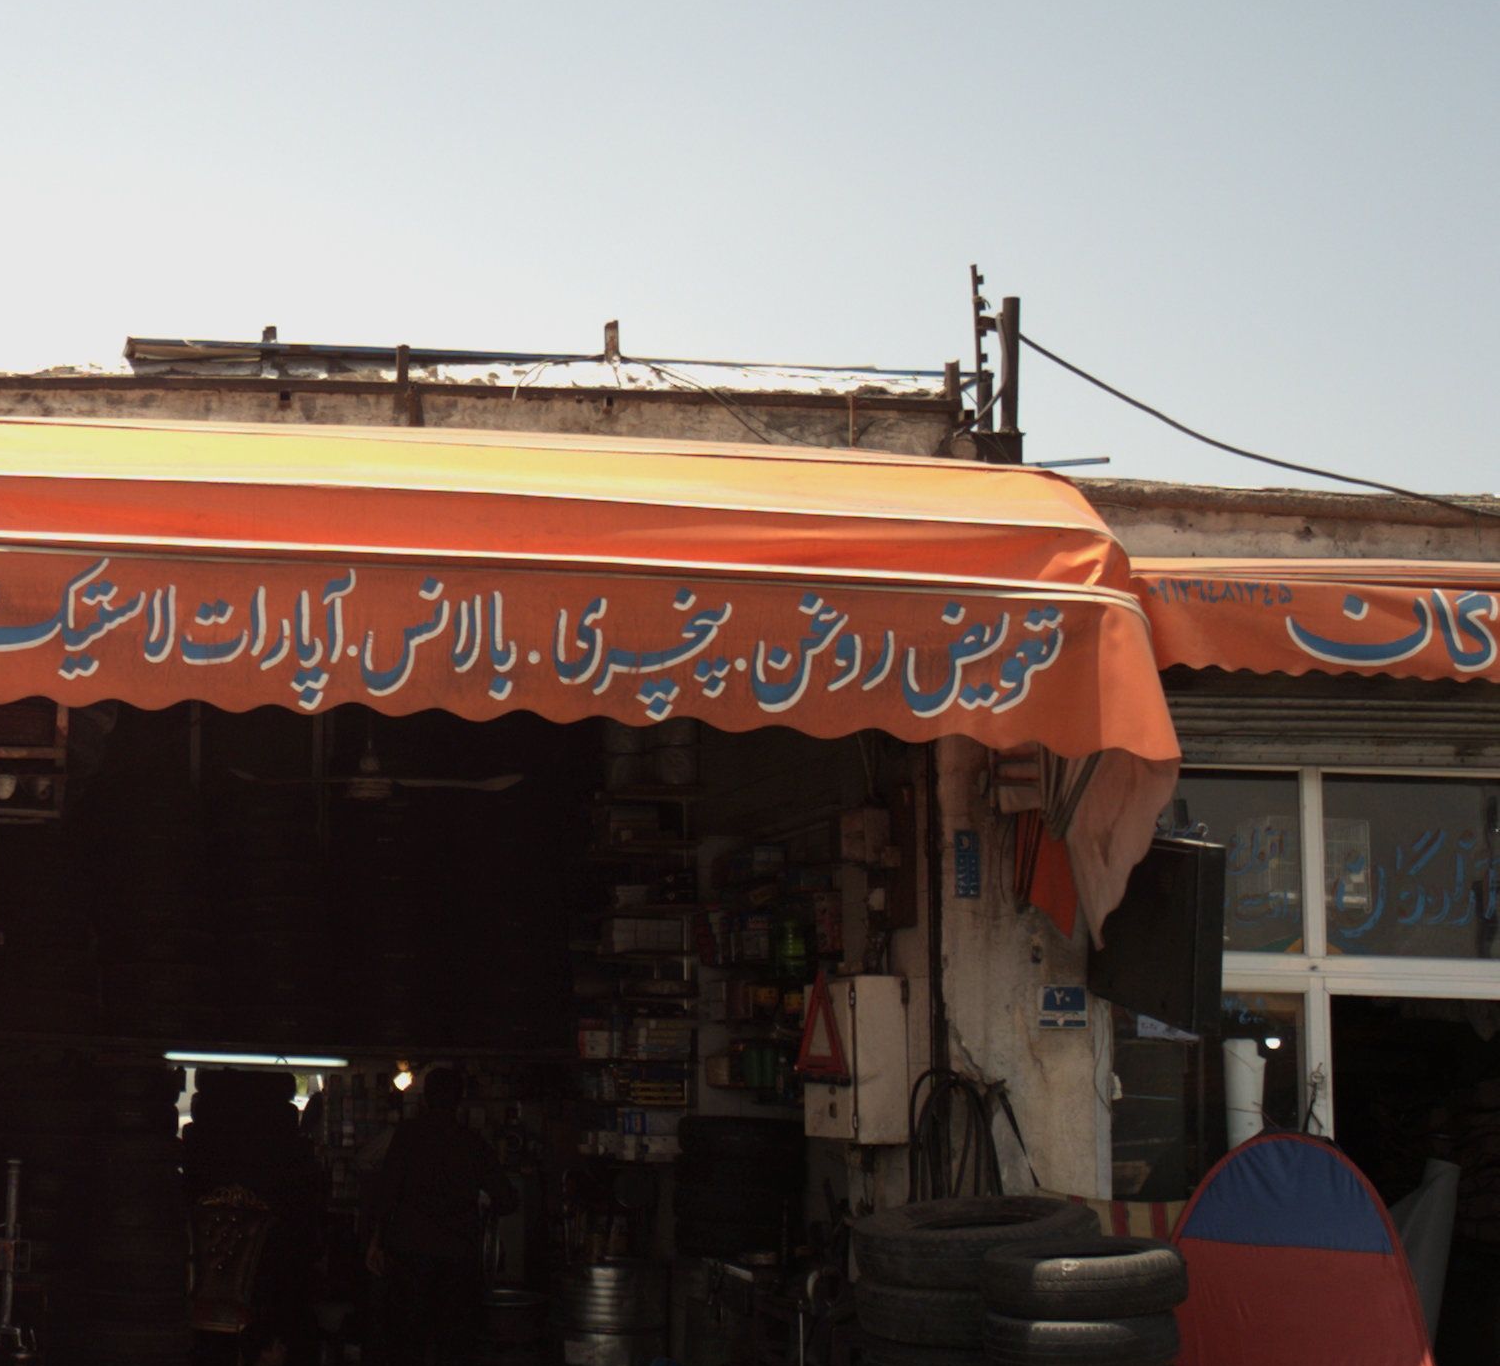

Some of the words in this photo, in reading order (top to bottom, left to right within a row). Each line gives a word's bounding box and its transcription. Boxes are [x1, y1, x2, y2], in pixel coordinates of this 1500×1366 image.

[180, 567, 357, 711] آپارات
[901, 601, 1065, 719] تعویض
[1053, 990, 1071, 1006] ۲۰
